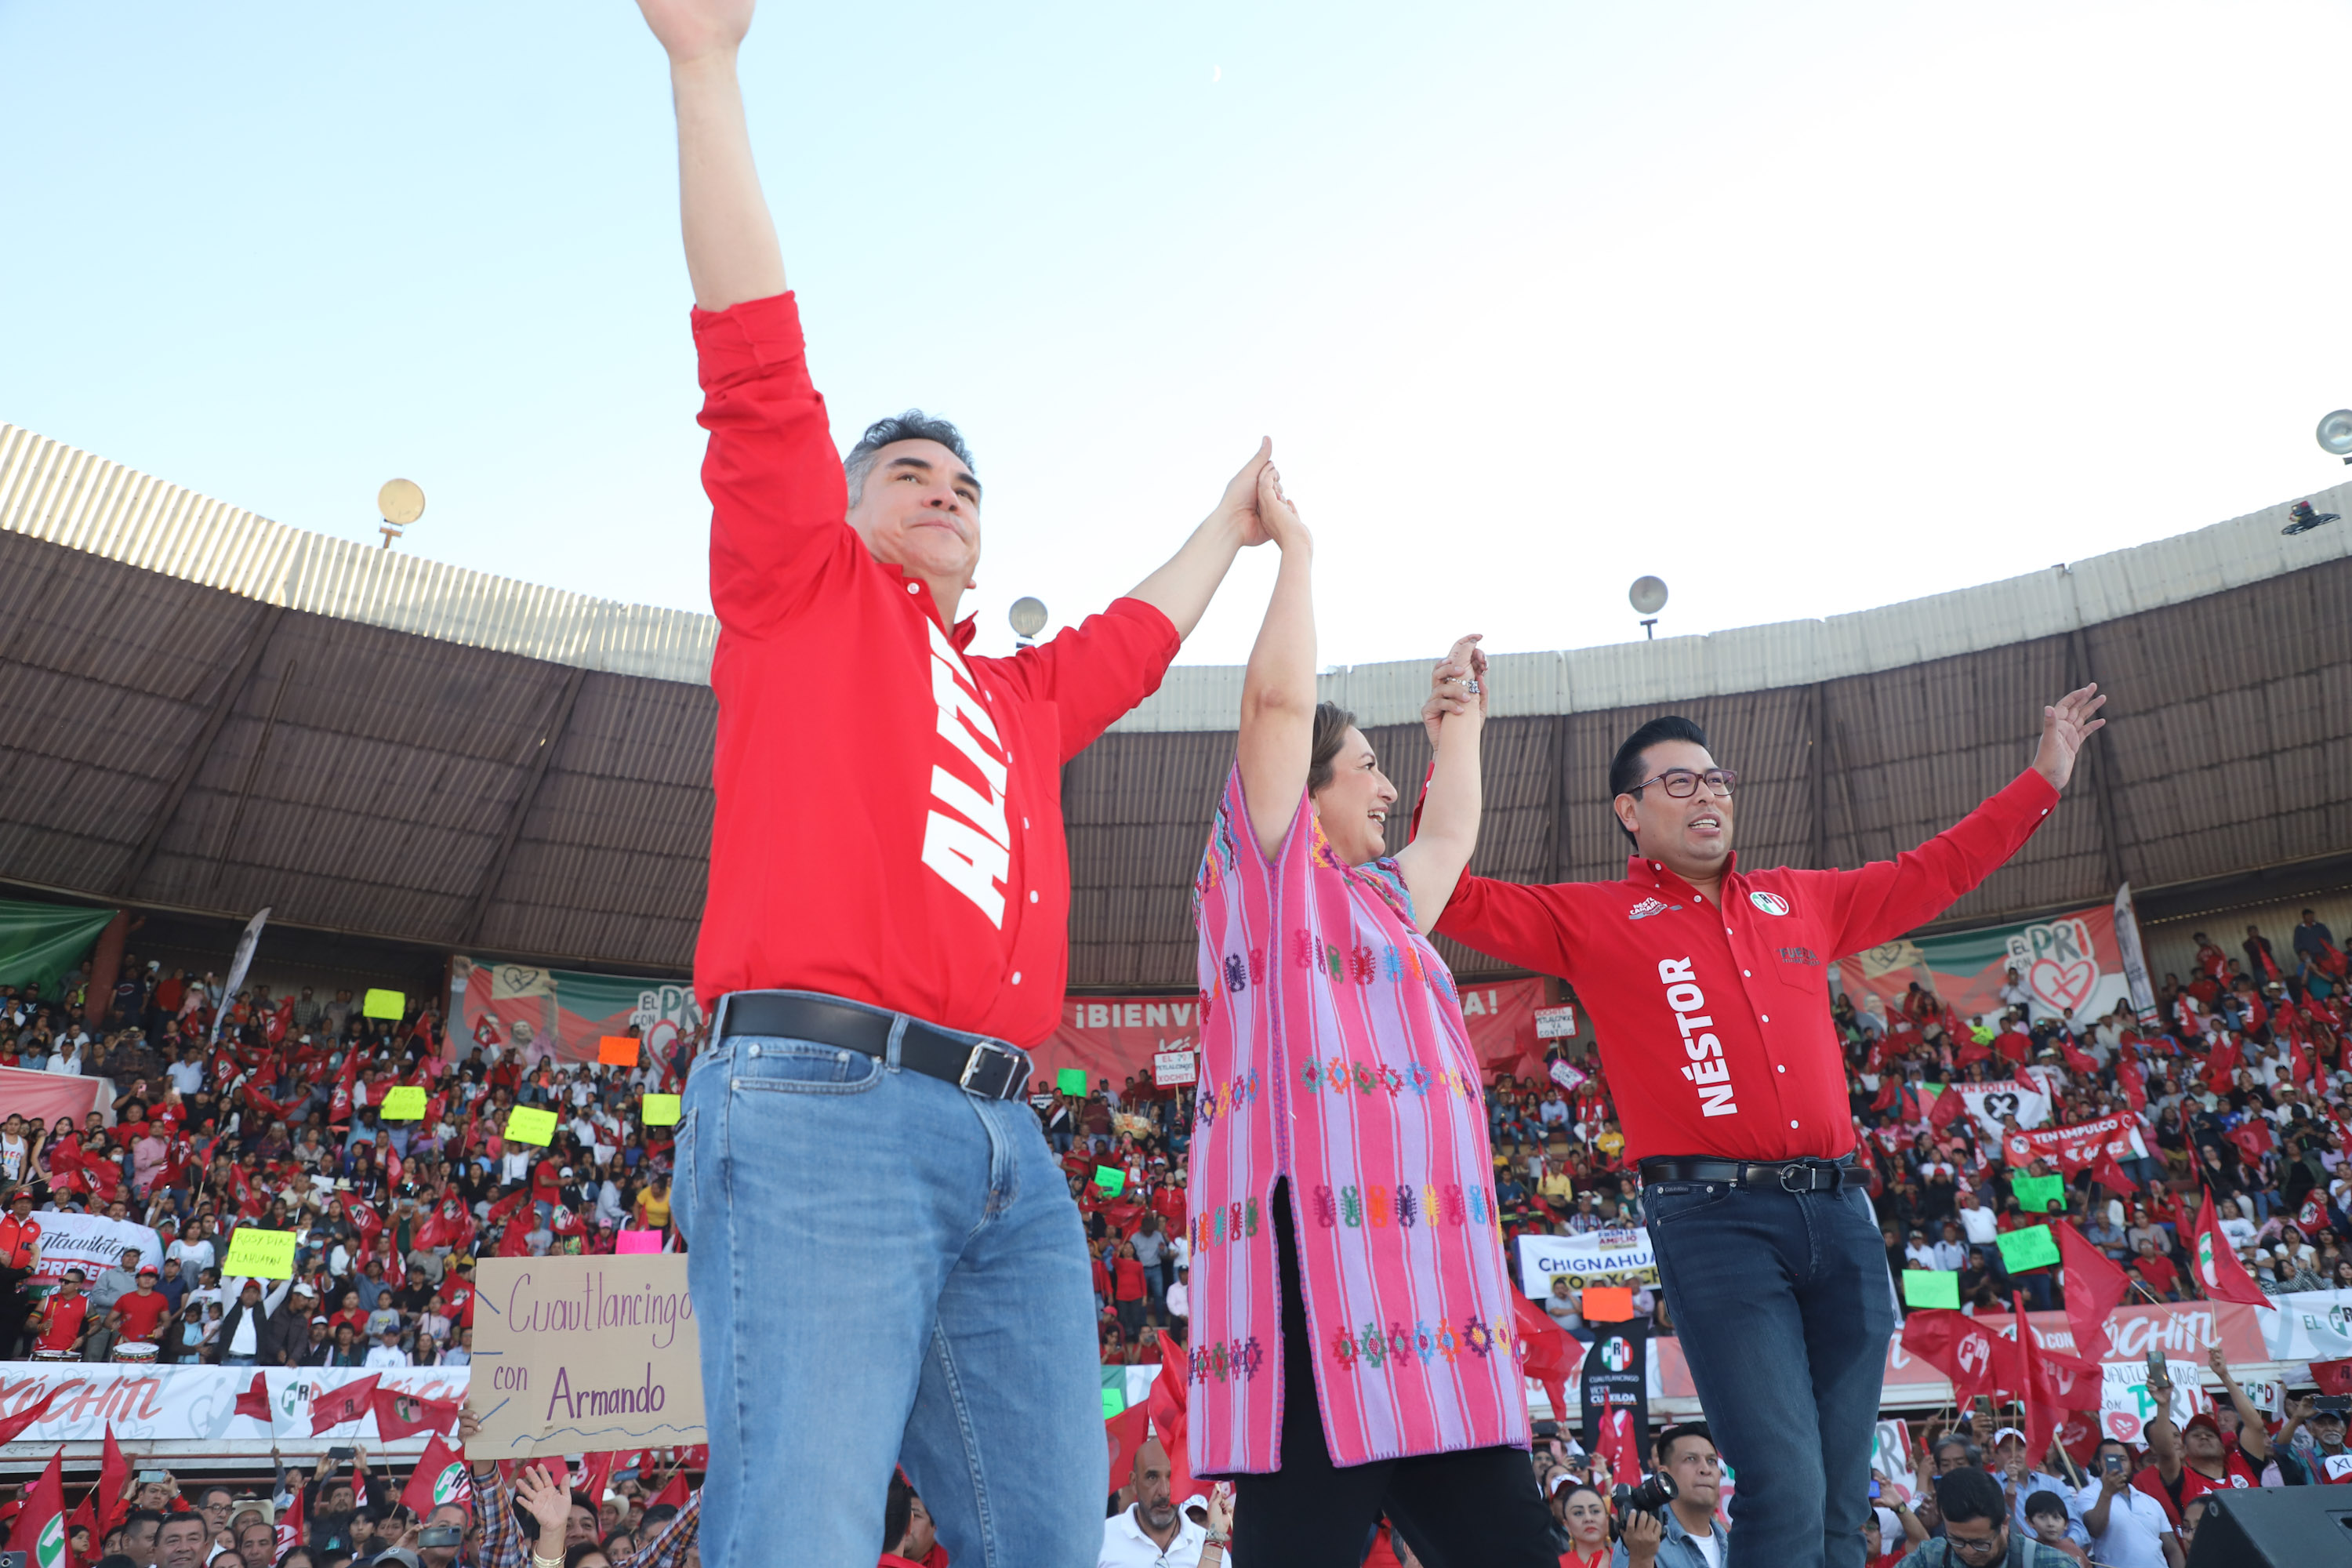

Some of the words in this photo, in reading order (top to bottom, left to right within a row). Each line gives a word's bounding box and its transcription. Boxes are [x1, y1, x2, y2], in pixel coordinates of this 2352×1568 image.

[1753, 893, 1787, 910] PRI
[2010, 939, 2031, 956] EL
[2029, 922, 2089, 964] PRI
[641, 995, 659, 1011] EL
[1657, 956, 1739, 1118] NÉSTOR
[2032, 1119, 2119, 1145] TENAMPULCO
[236, 1232, 263, 1246] ROSY
[508, 1271, 693, 1349] Cuautlancingo
[2302, 1315, 2322, 1330] EL
[1602, 1341, 1630, 1363] PRI
[493, 1365, 528, 1392] con
[546, 1361, 666, 1421] Armando
[2247, 1384, 2272, 1399] PRI
[1869, 1420, 1914, 1481] RI
